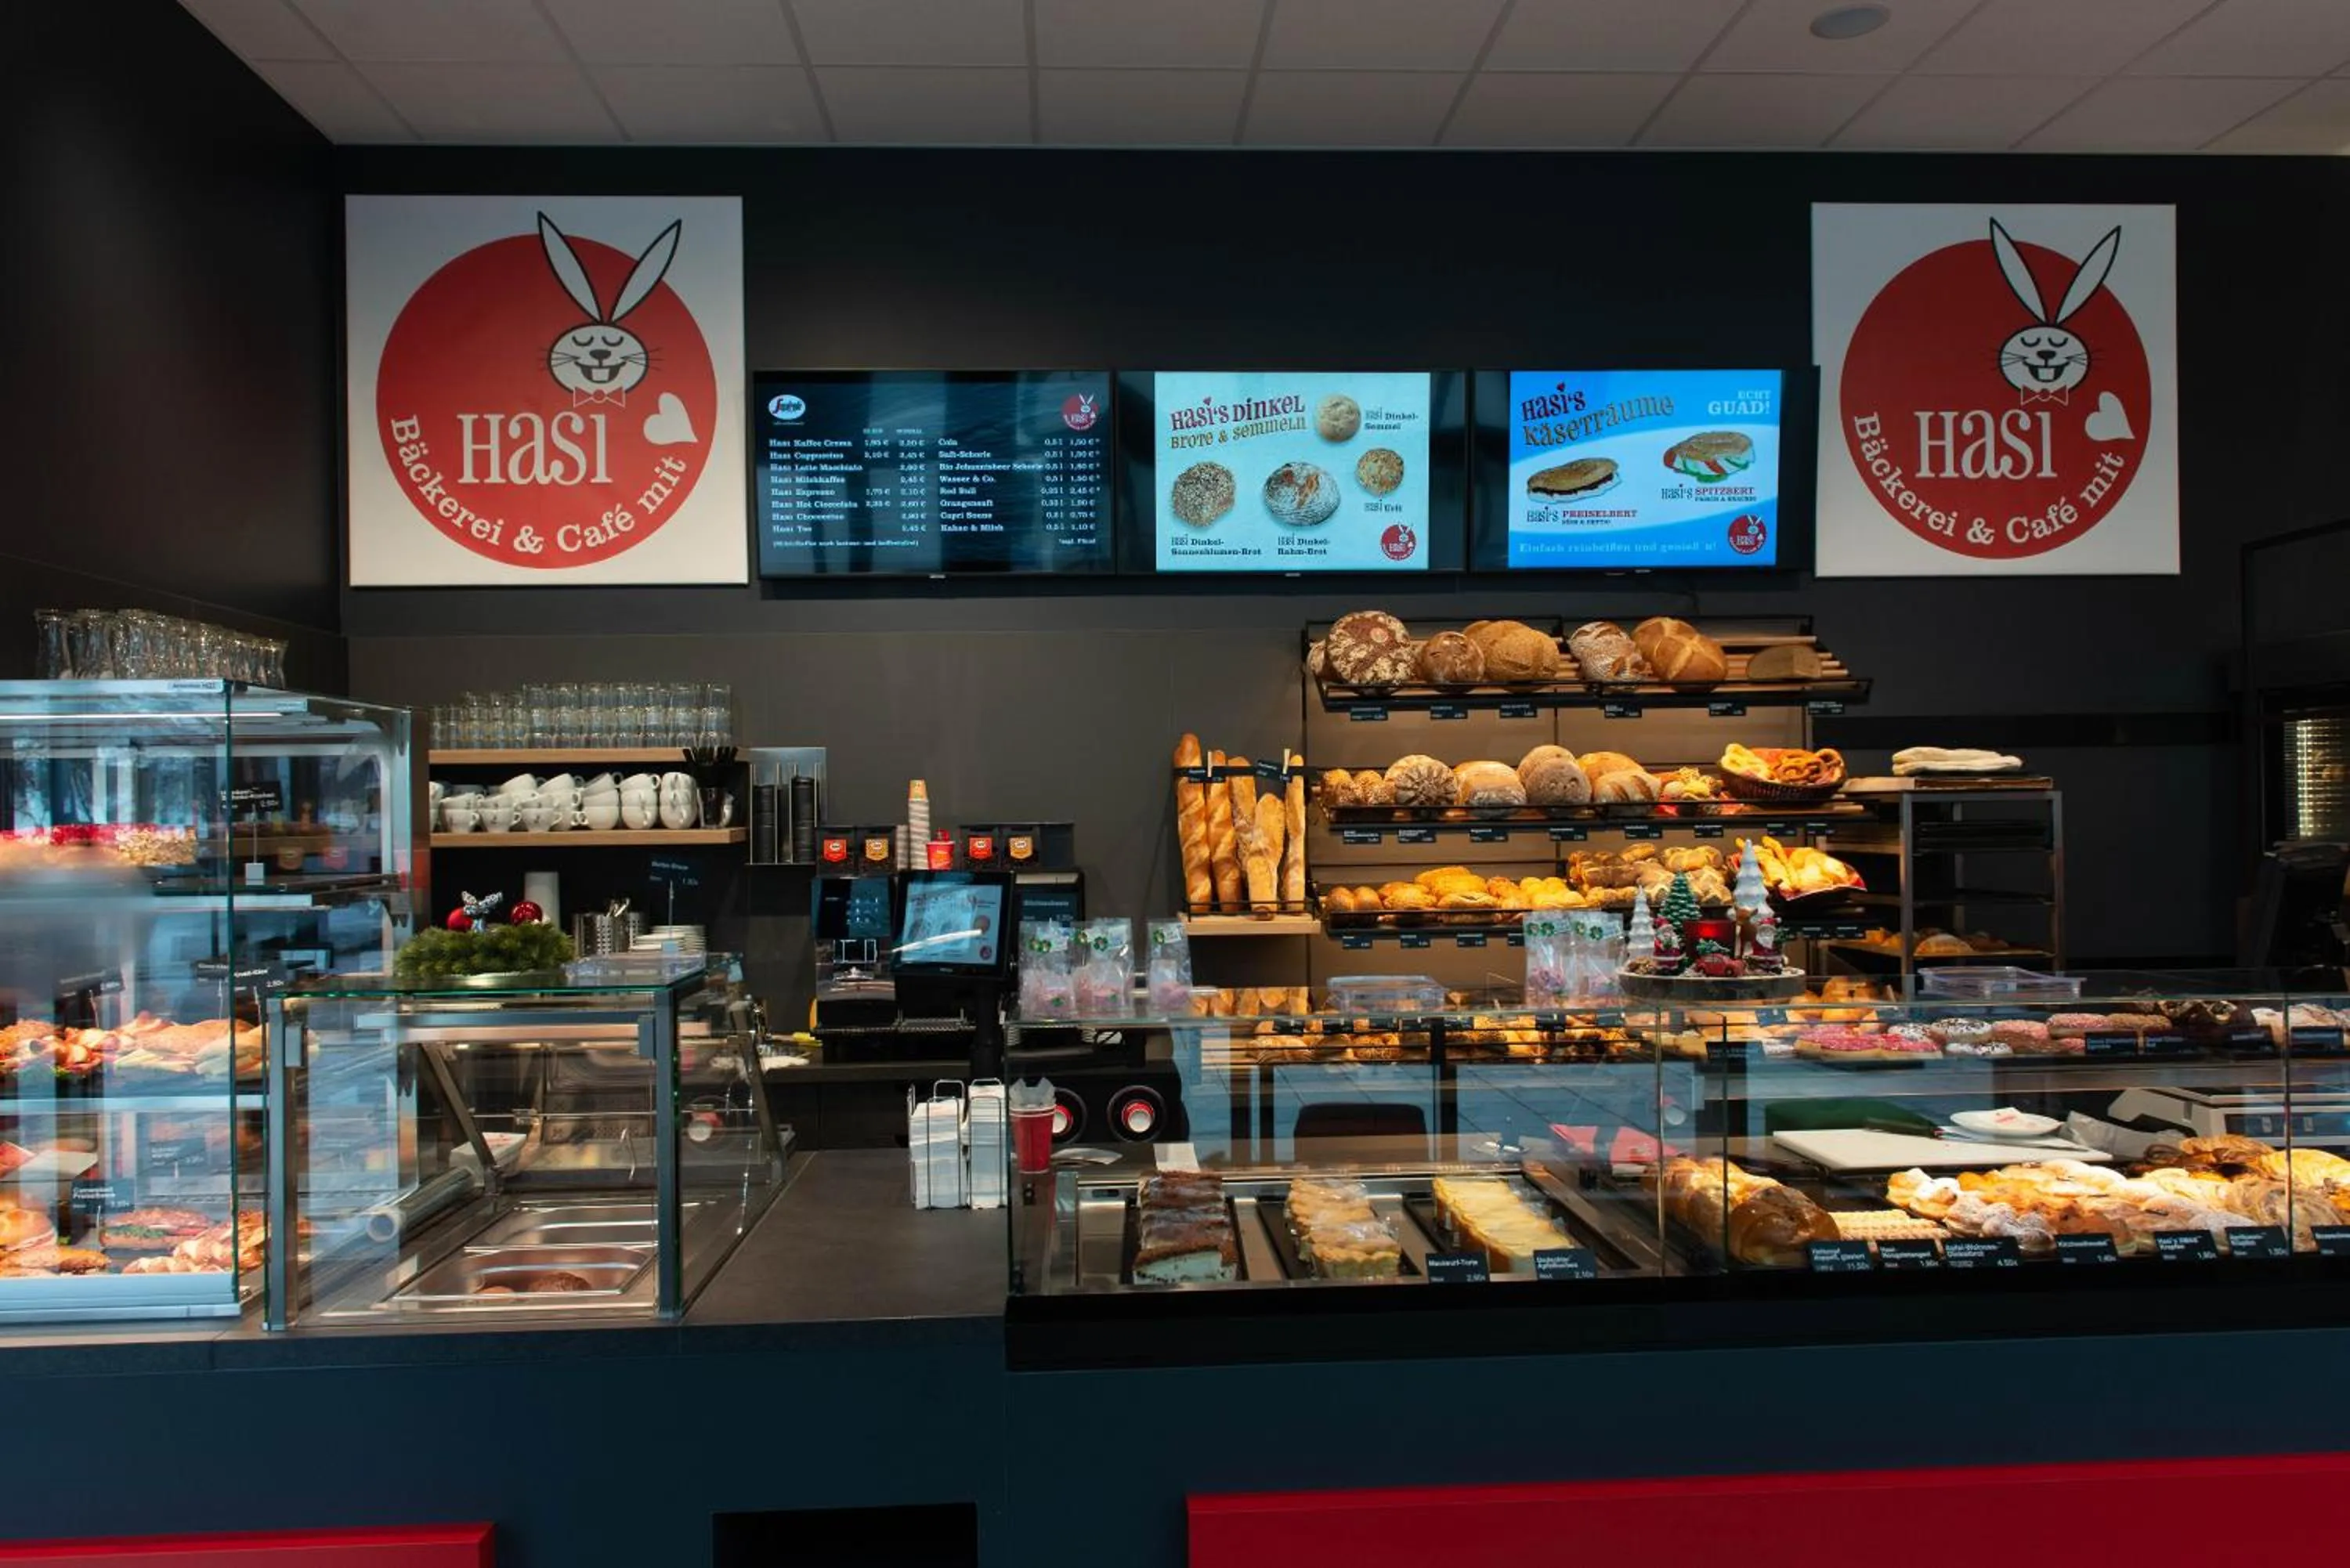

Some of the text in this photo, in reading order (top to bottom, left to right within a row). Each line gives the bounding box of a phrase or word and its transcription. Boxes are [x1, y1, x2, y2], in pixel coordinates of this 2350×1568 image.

[1737, 390, 1772, 399] ECHT
[1707, 400, 1771, 415] GUAD!
[1384, 412, 1419, 421] Dinkel-
[1217, 430, 1229, 444] &
[794, 439, 822, 447] Kaffee
[823, 439, 853, 447] Crema
[938, 450, 991, 459] Saft-Schorle
[939, 463, 953, 471] Bio
[955, 463, 1010, 471] Johannisbeer
[1853, 411, 2125, 544] Bäckerei & Café mit
[391, 414, 688, 554] Bäckerei & Café mit
[795, 488, 836, 497] Espresso
[1694, 486, 1755, 495] SPITZBERT
[796, 500, 812, 509] Hot
[939, 499, 994, 508] Orangensaft
[939, 511, 964, 520] Capri
[1562, 509, 1638, 518] PREISELBERT
[1519, 543, 1564, 553] Einfach
[1567, 542, 1632, 553] reinbeißen
[1635, 542, 1656, 553] und
